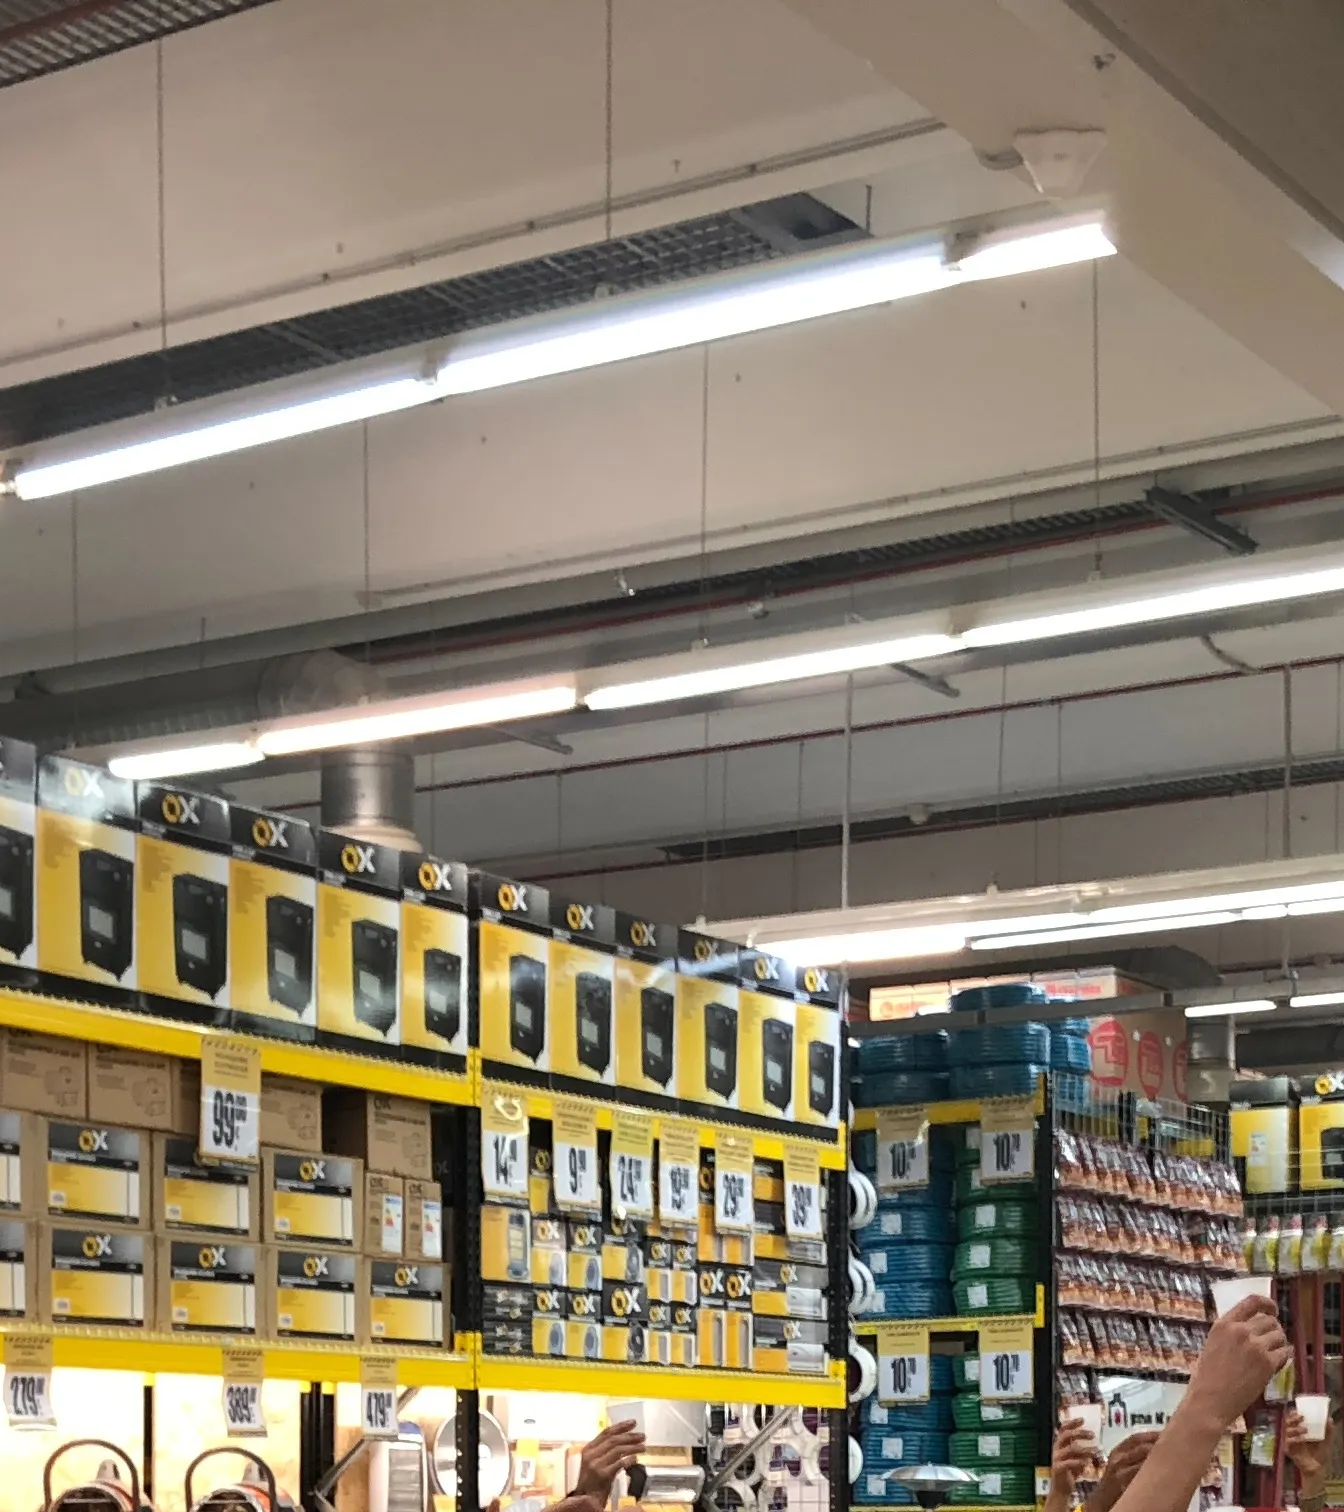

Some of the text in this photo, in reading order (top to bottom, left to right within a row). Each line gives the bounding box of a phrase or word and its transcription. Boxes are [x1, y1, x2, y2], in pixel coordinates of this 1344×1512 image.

[64, 766, 105, 798] OX
[162, 794, 201, 825] OX
[253, 817, 289, 849] OX
[341, 844, 376, 874] OX
[418, 861, 452, 891] OX
[498, 883, 528, 912] OX
[567, 904, 594, 930] OX
[631, 921, 656, 946] OX
[755, 957, 779, 980] OX
[804, 967, 830, 993] OX
[212, 1089, 236, 1148] 99
[79, 1129, 108, 1152] OX
[299, 1160, 326, 1183] OX
[537, 1220, 559, 1240] OX
[575, 1225, 595, 1246] OX
[82, 1234, 113, 1259] OX
[198, 1246, 227, 1270] OX
[303, 1256, 329, 1278] OX
[394, 1266, 419, 1287] OX
[700, 1269, 724, 1295] OX
[727, 1271, 752, 1298] OX
[537, 1289, 561, 1313] OX
[573, 1294, 595, 1316] OX
[611, 1287, 642, 1316] OX
[891, 1356, 906, 1394] 10
[993, 1353, 1009, 1392] 10
